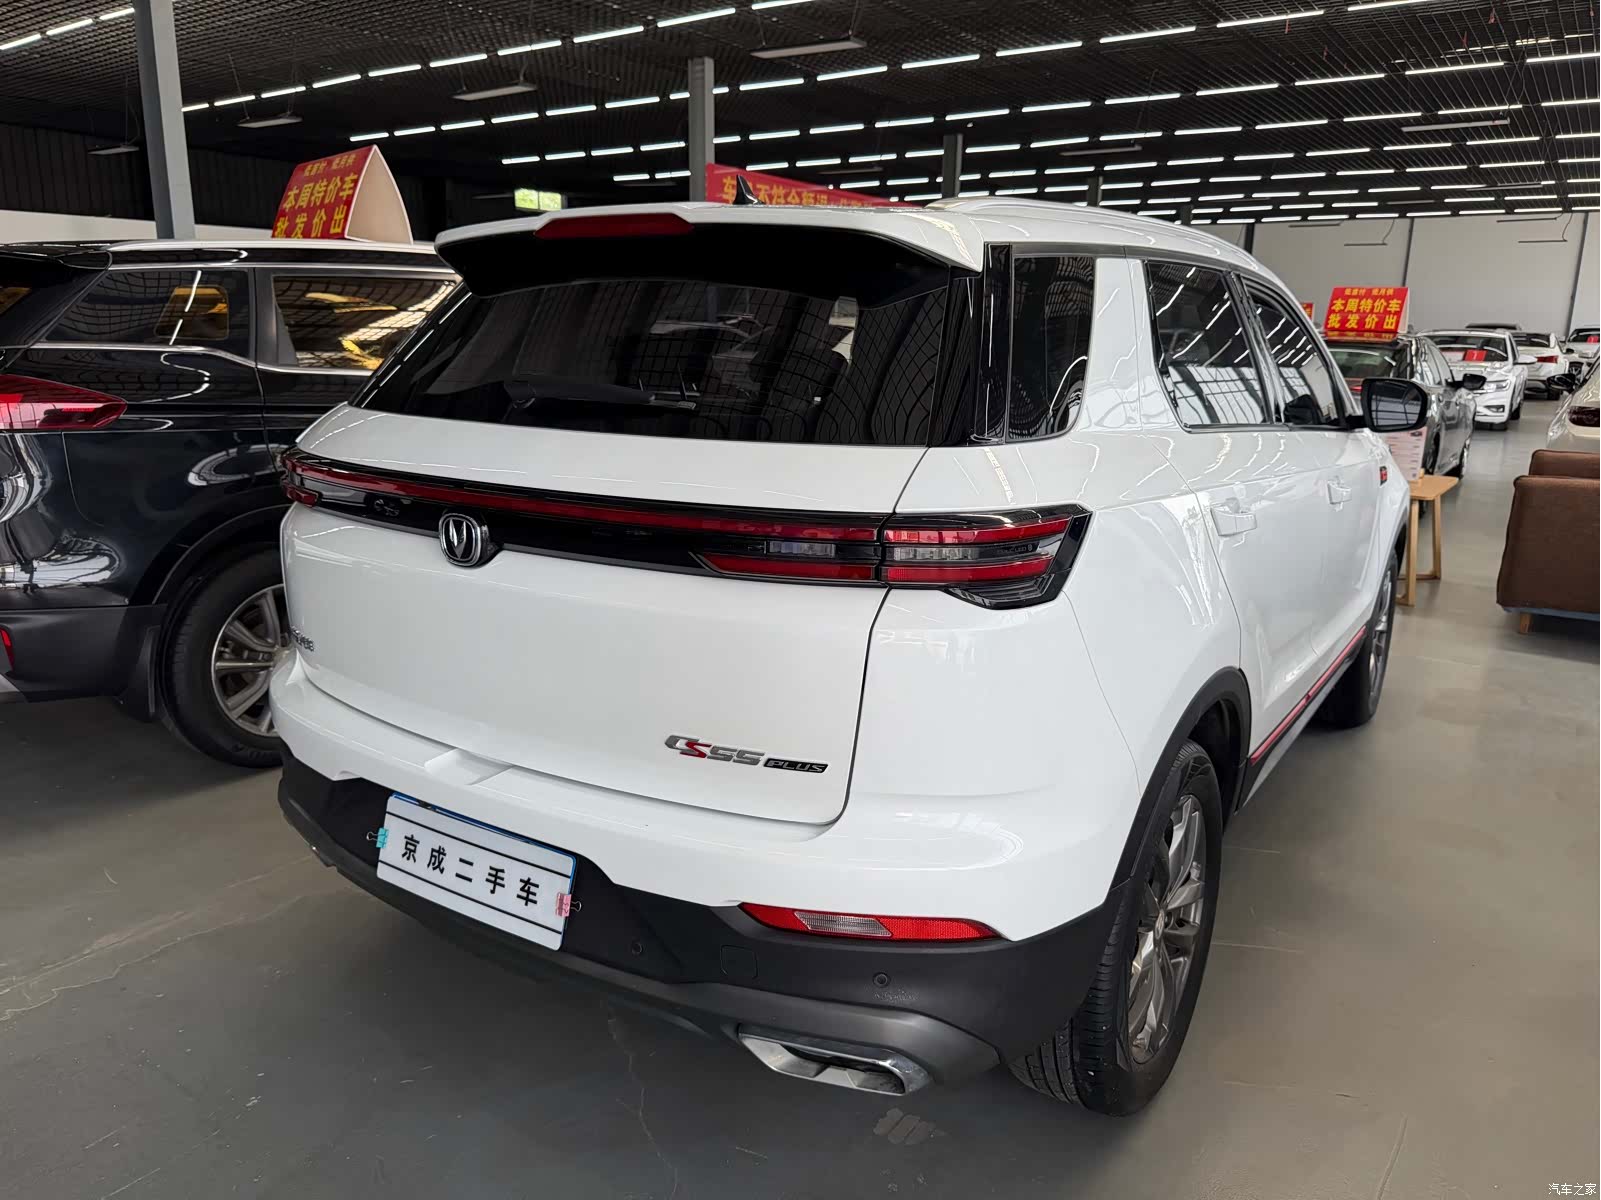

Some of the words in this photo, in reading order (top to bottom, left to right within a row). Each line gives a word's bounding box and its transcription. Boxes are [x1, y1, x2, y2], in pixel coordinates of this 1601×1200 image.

[283, 172, 359, 212] 本周特价车
[275, 204, 348, 238] 批发价出
[1327, 313, 1397, 329] 批发价出
[1331, 298, 1402, 313] 本周特价车
[664, 735, 766, 766] CS55
[765, 759, 828, 773] PLUS
[401, 834, 540, 906] 京成二手车
